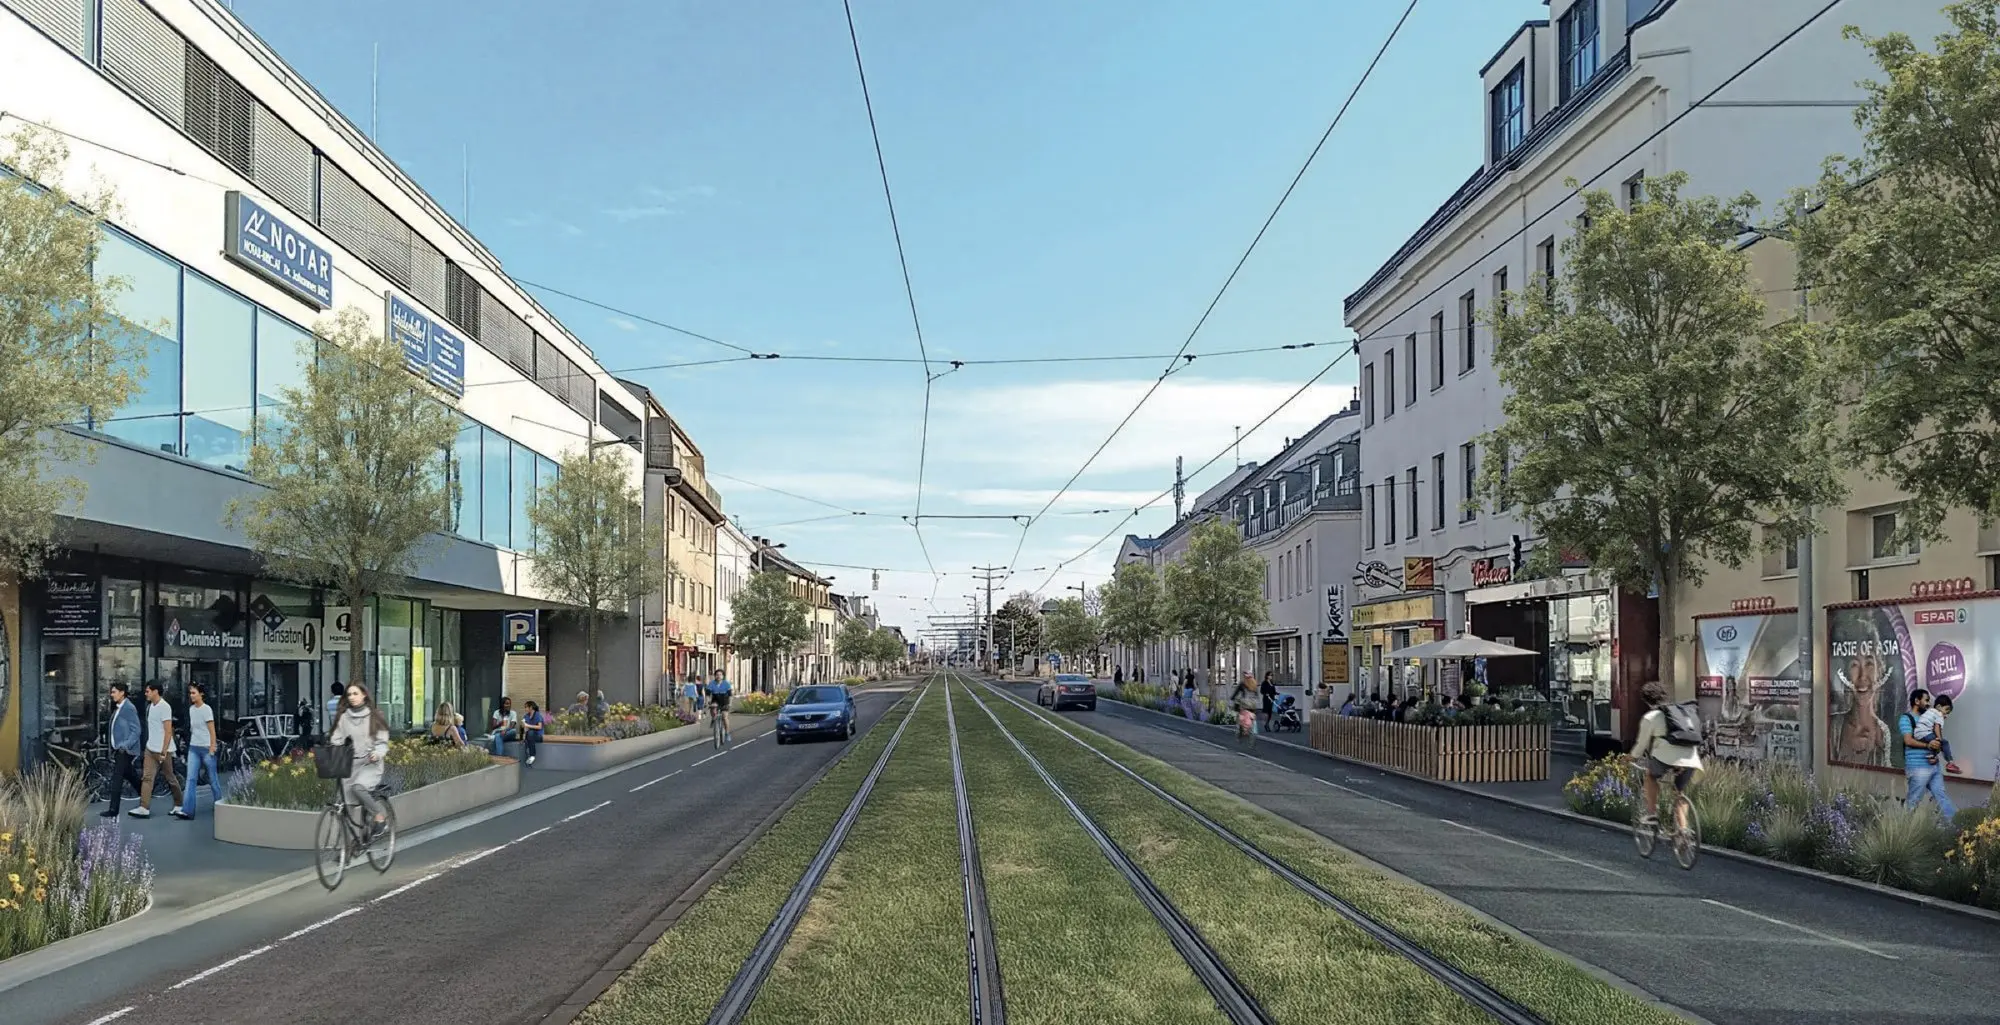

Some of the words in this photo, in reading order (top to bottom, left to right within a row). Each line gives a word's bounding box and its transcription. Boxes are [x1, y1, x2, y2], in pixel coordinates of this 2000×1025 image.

[270, 222, 329, 282] NOTAR
[1327, 584, 1345, 637] KARATE
[1920, 611, 1955, 623] SPAR
[180, 629, 220, 647] Domino's
[221, 631, 244, 648] Pizza
[263, 625, 303, 644] Hansaton
[510, 620, 530, 642] P
[1832, 640, 1857, 657] TASTE
[1860, 640, 1873, 656] OF
[1876, 639, 1899, 656] ASIA
[1930, 654, 1958, 677] NEU!
